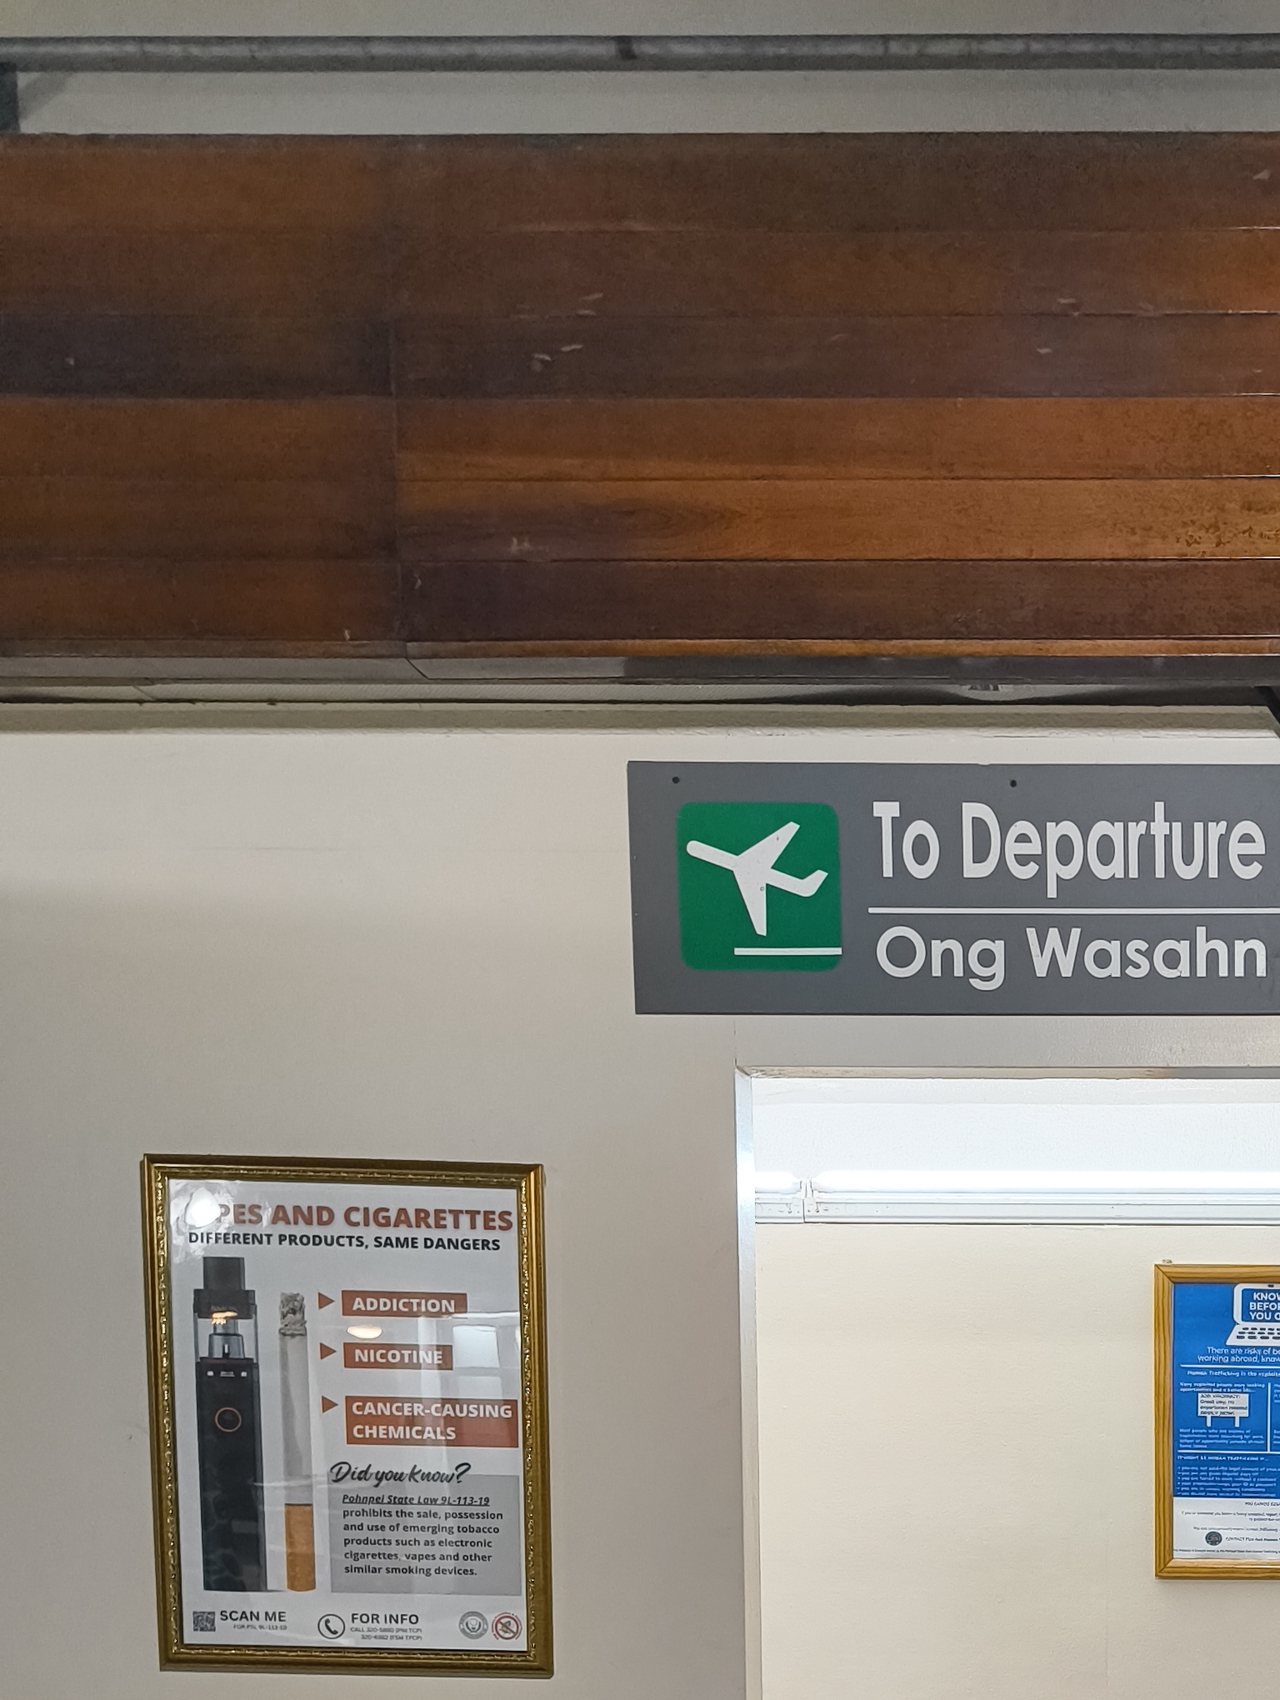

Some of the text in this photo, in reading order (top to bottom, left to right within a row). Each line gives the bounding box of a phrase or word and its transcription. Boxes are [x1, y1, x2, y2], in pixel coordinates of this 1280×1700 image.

[873, 801, 938, 878] To
[962, 802, 1264, 897] Departure
[877, 926, 1003, 989] Ong
[1026, 927, 1265, 976] Wasahn
[271, 1204, 334, 1226] AND
[343, 1206, 512, 1231] CIGARETTES
[188, 1232, 500, 1250] DIFFERENT PRODUCTS, SAME DANGERS
[352, 1297, 455, 1313] ADDICTION
[1249, 1311, 1271, 1320] YOU
[354, 1347, 442, 1365] NICOTINE
[352, 1401, 512, 1419] CANCER-CAUSING
[352, 1423, 456, 1440] CHEMICALS
[342, 1494, 385, 1505] Pohnpei
[387, 1495, 414, 1506] State
[417, 1496, 438, 1506] Law
[343, 1508, 502, 1520] prohibits the sale, possession
[343, 1522, 363, 1531] and
[388, 1522, 400, 1531] of
[402, 1524, 454, 1534] emerging
[457, 1524, 499, 1533] tobacco
[343, 1536, 391, 1547] products
[395, 1537, 420, 1546] such
[438, 1538, 491, 1547] electronic
[344, 1550, 492, 1562] cigarettes, vapes and other
[344, 1564, 476, 1576] similar smoking devices.
[220, 1610, 285, 1621] SCAN ME
[351, 1613, 418, 1624] FOR INFO
